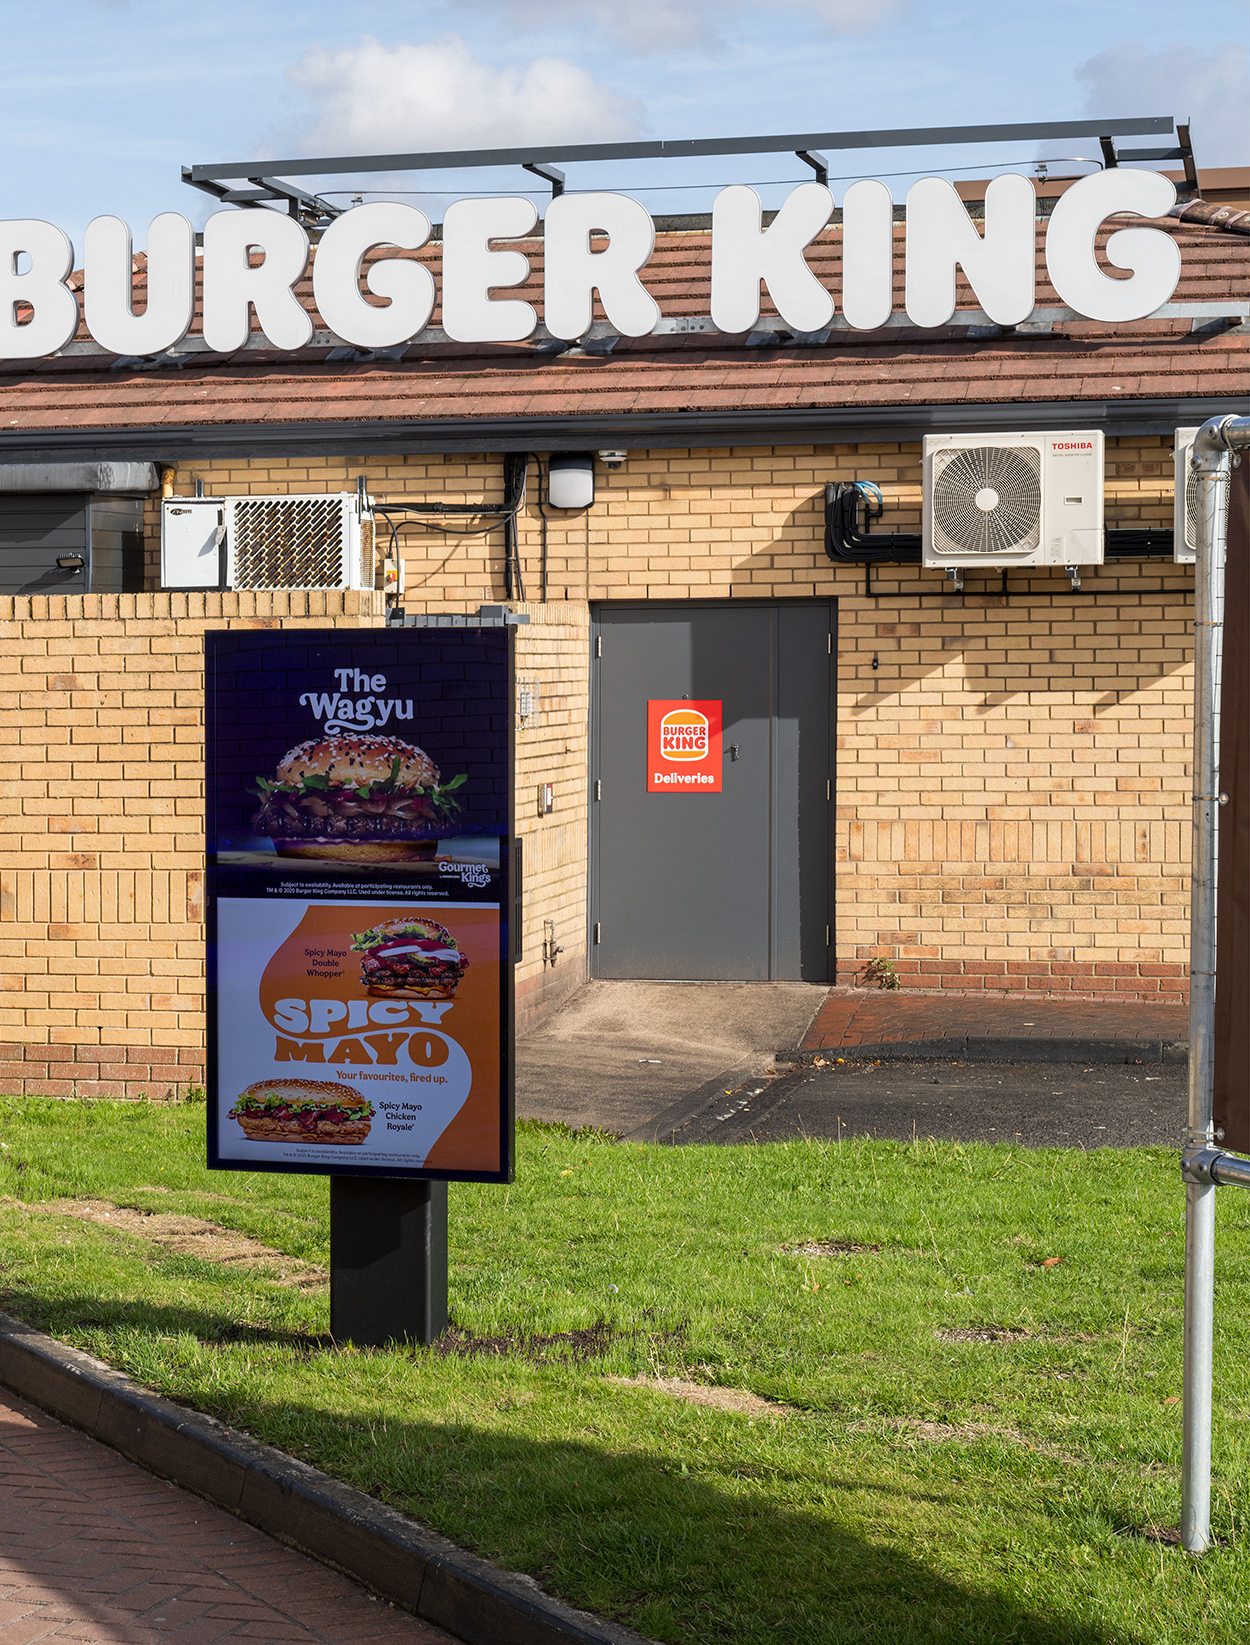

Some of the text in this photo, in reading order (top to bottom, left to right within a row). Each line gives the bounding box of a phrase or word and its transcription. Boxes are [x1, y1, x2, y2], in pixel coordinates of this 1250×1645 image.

[710, 168, 1182, 333] KING
[334, 668, 386, 692] The
[300, 692, 414, 734] Wagyu
[663, 726, 706, 736] BURGER
[663, 736, 706, 749] KING
[654, 772, 714, 784] Deliveries
[438, 861, 488, 874] Gourmet
[461, 872, 491, 888] Kings
[304, 948, 347, 958] Spicy Mayo
[274, 998, 454, 1033] SPICY
[274, 1031, 450, 1067] MAYO
[336, 1070, 448, 1085] Your favourites, fired up.
[379, 1102, 422, 1112] Spicy Mayo
[386, 1112, 416, 1120] Chicken
